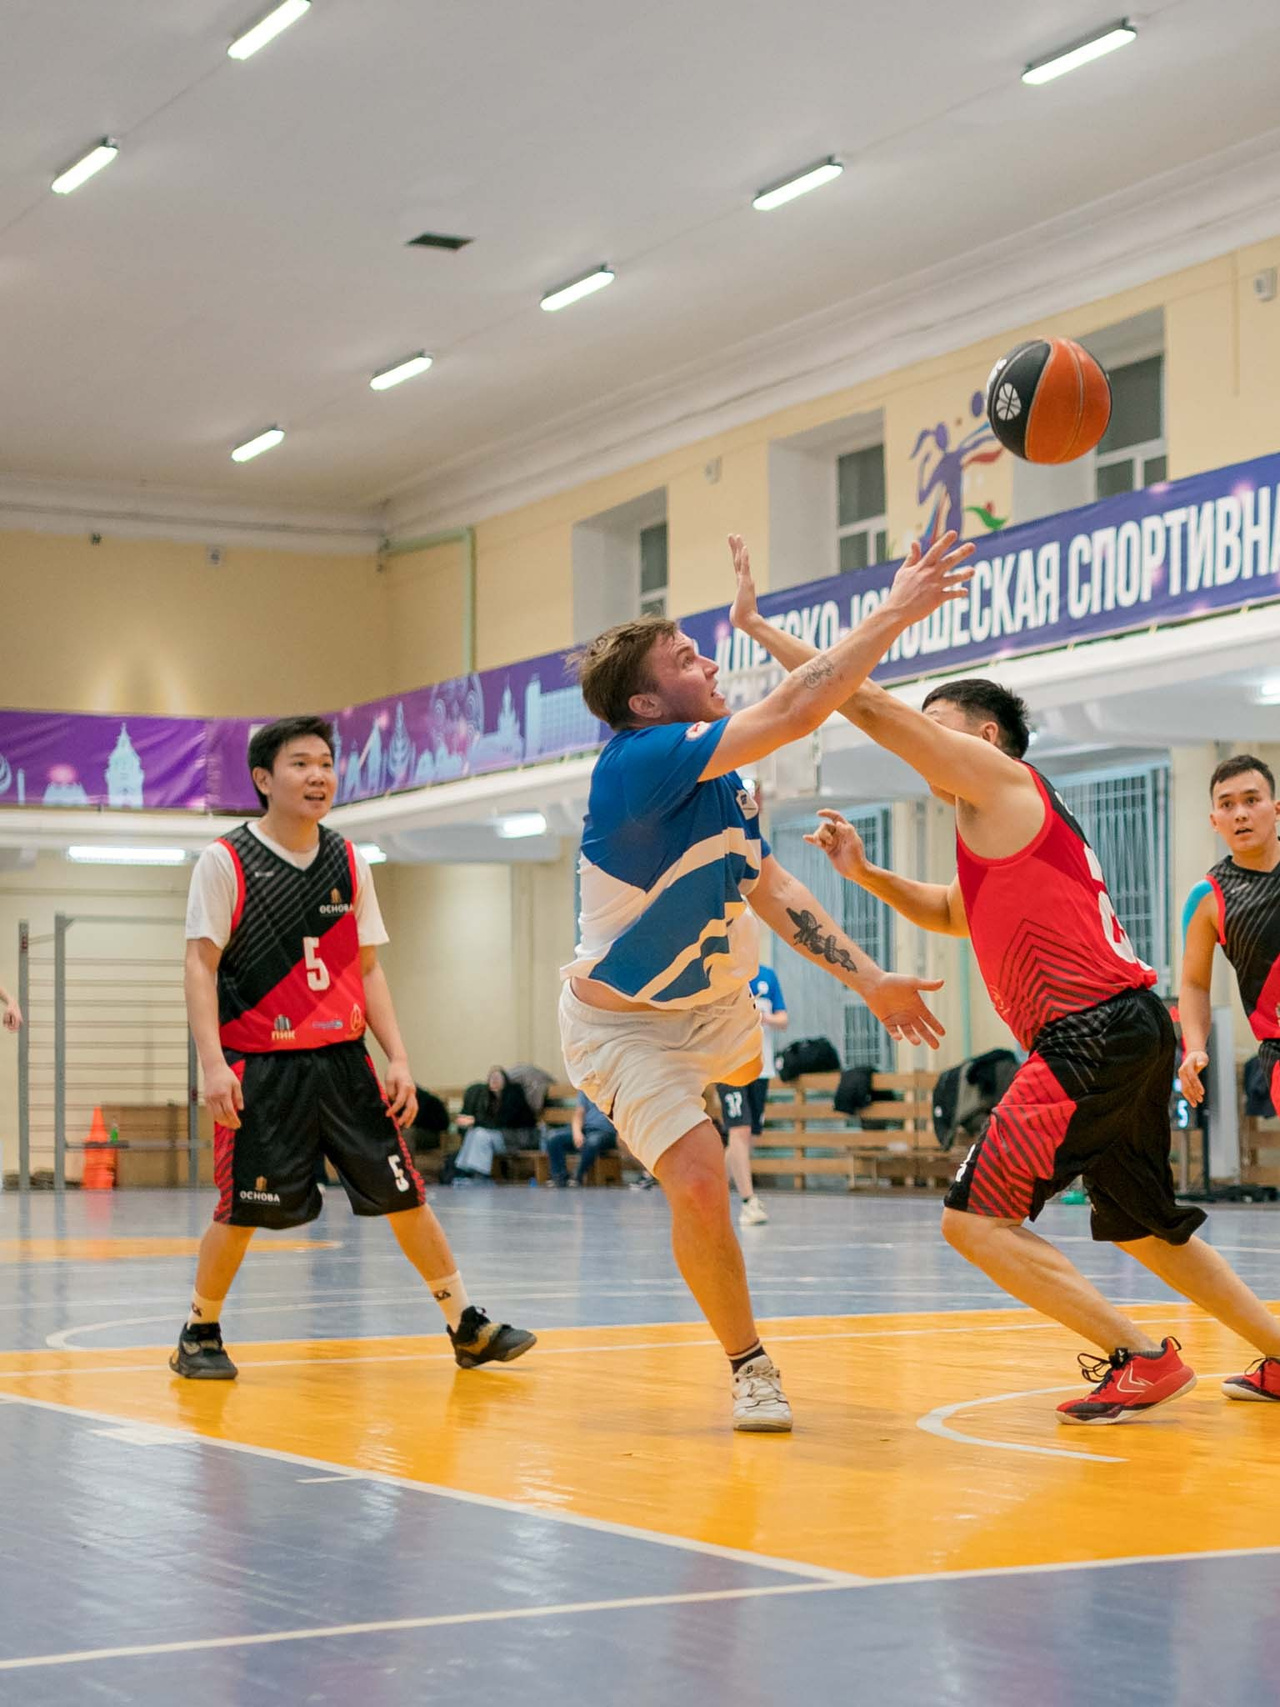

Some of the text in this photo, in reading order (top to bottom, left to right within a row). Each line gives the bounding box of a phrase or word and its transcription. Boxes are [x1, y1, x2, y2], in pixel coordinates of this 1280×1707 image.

[303, 936, 331, 991] 5
[387, 1154, 410, 1192] 5
[239, 1190, 281, 1203] ОСНОВА
